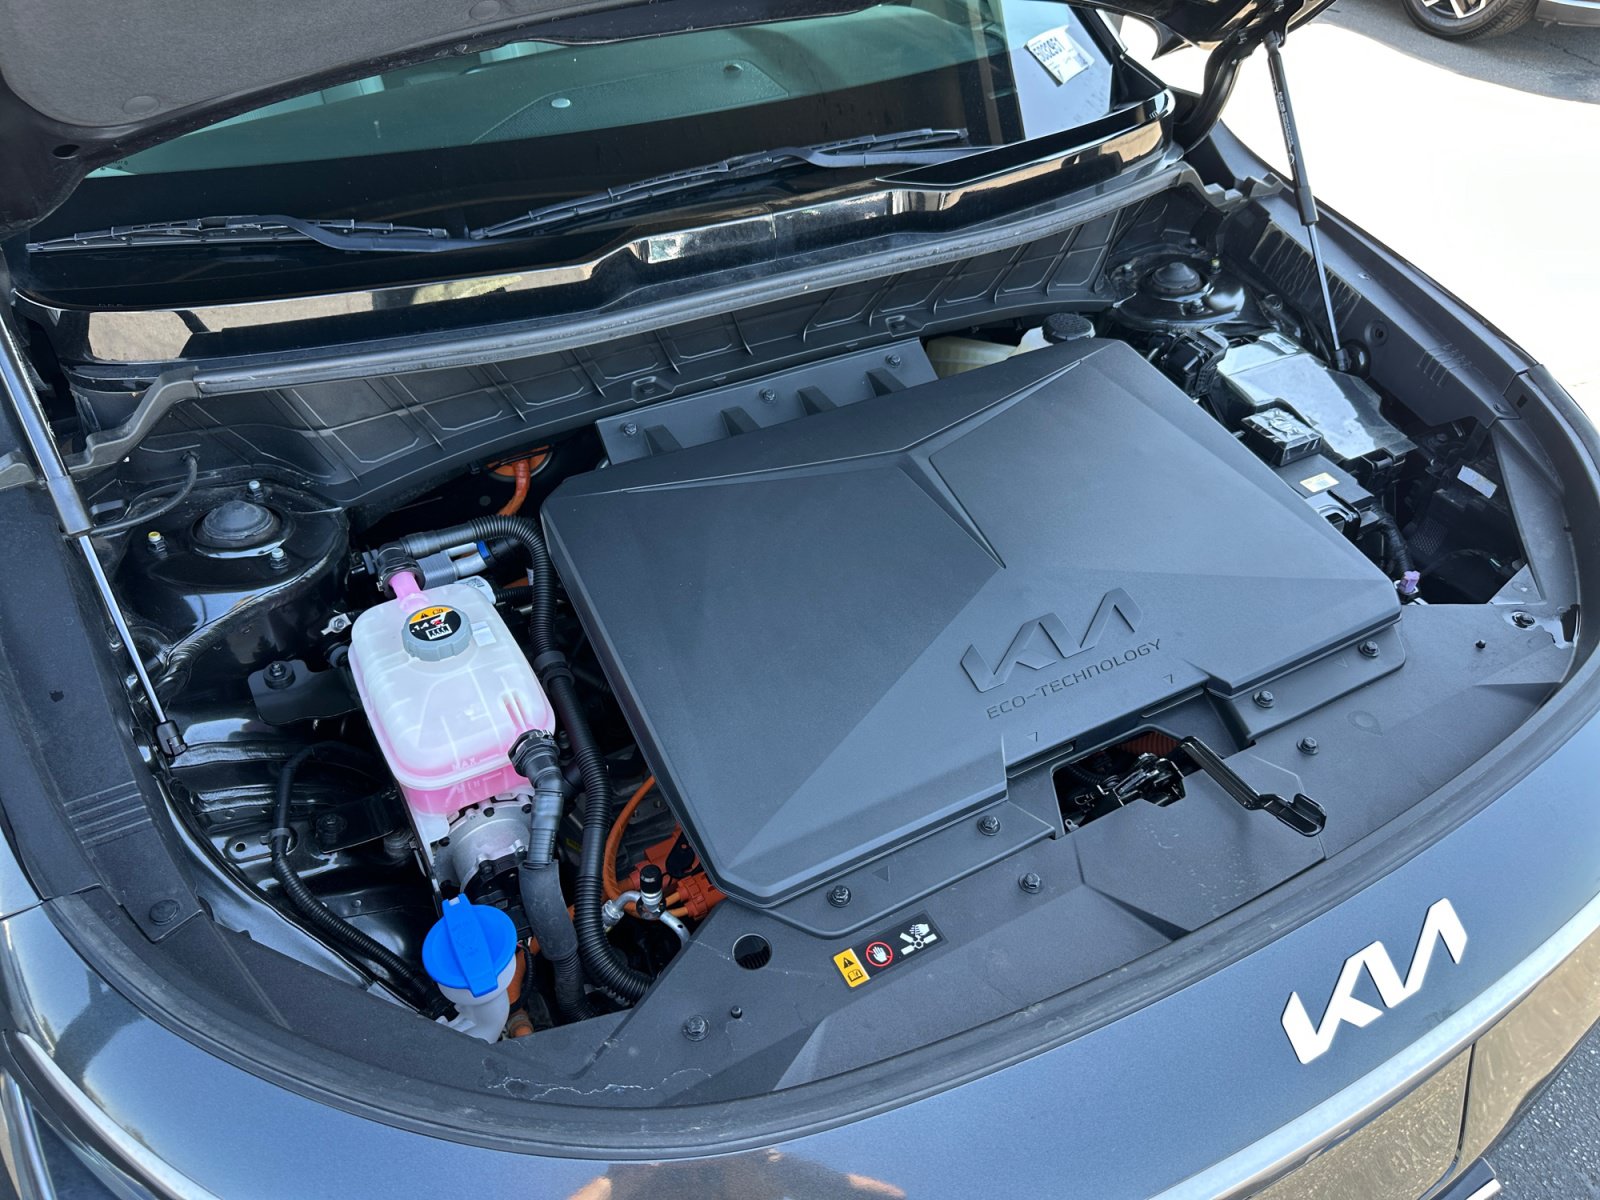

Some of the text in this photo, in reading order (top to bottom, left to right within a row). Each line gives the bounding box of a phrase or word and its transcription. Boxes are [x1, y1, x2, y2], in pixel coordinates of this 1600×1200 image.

[959, 587, 1143, 693] KIA
[986, 638, 1161, 719] ECO-TECHNOLOGY
[1280, 897, 1468, 1065] KIA
